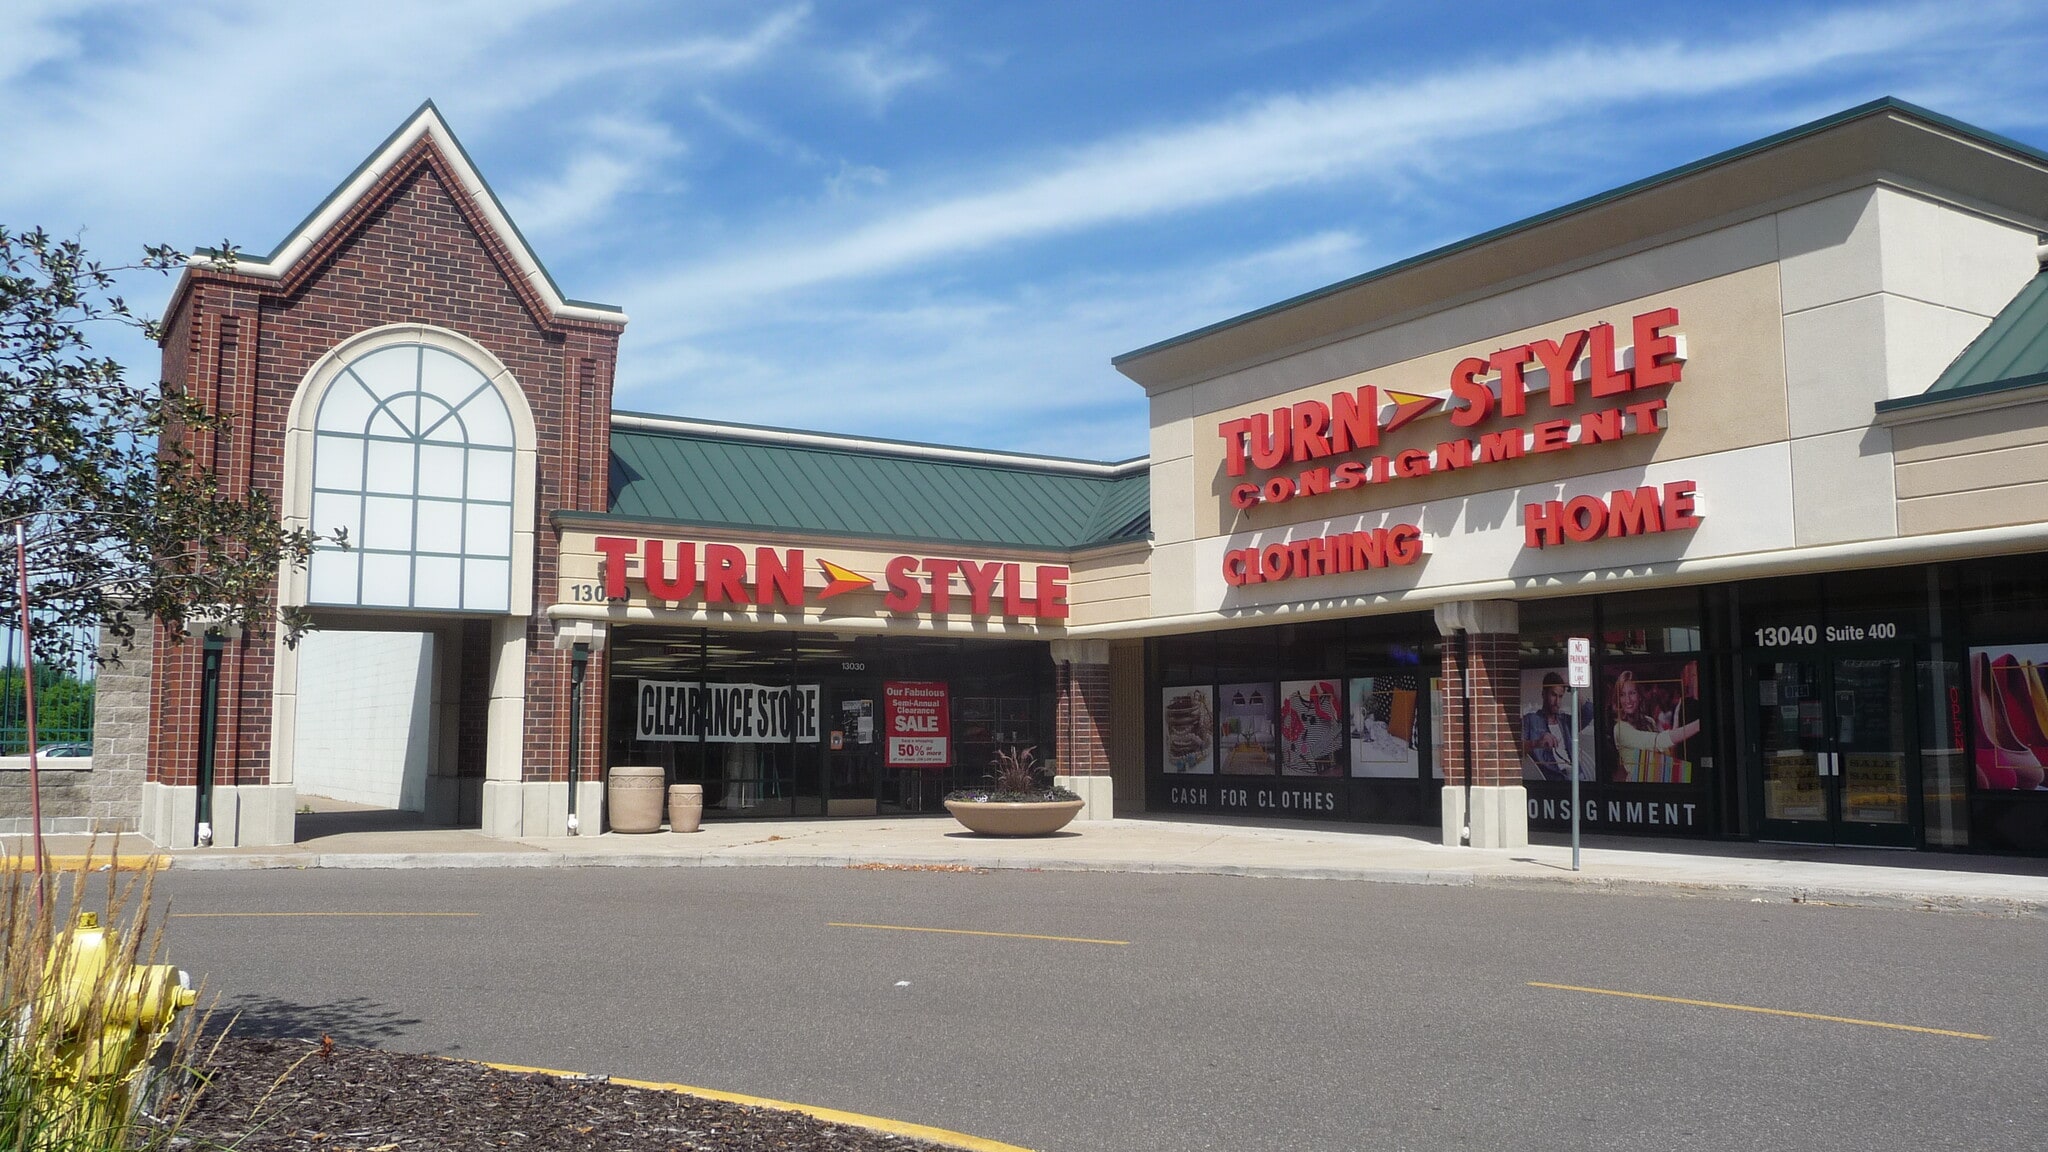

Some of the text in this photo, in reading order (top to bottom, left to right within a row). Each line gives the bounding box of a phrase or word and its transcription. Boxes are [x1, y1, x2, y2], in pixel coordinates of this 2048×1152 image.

[1219, 307, 1681, 477] TURN STYLE
[1231, 399, 1667, 509] CONSIGNMENT
[1223, 480, 1700, 586] CLOTHING HOME
[595, 536, 1069, 618] TURN STYLE
[1755, 622, 1896, 647] 13040 Suite 400
[1575, 643, 1583, 653] NO
[842, 662, 865, 671] 13030
[1570, 655, 1588, 664] PARKING
[887, 687, 945, 697] Our Fabulous
[641, 684, 752, 738] CLEARANCE
[757, 688, 816, 738] STORE
[892, 699, 940, 707] Semi-Annual
[897, 707, 935, 715] Clearance
[895, 715, 939, 732] SALE
[1950, 687, 1965, 752] OPEN
[898, 744, 925, 757] 50%
[1171, 787, 1335, 811] CASH FOR CLOTHES
